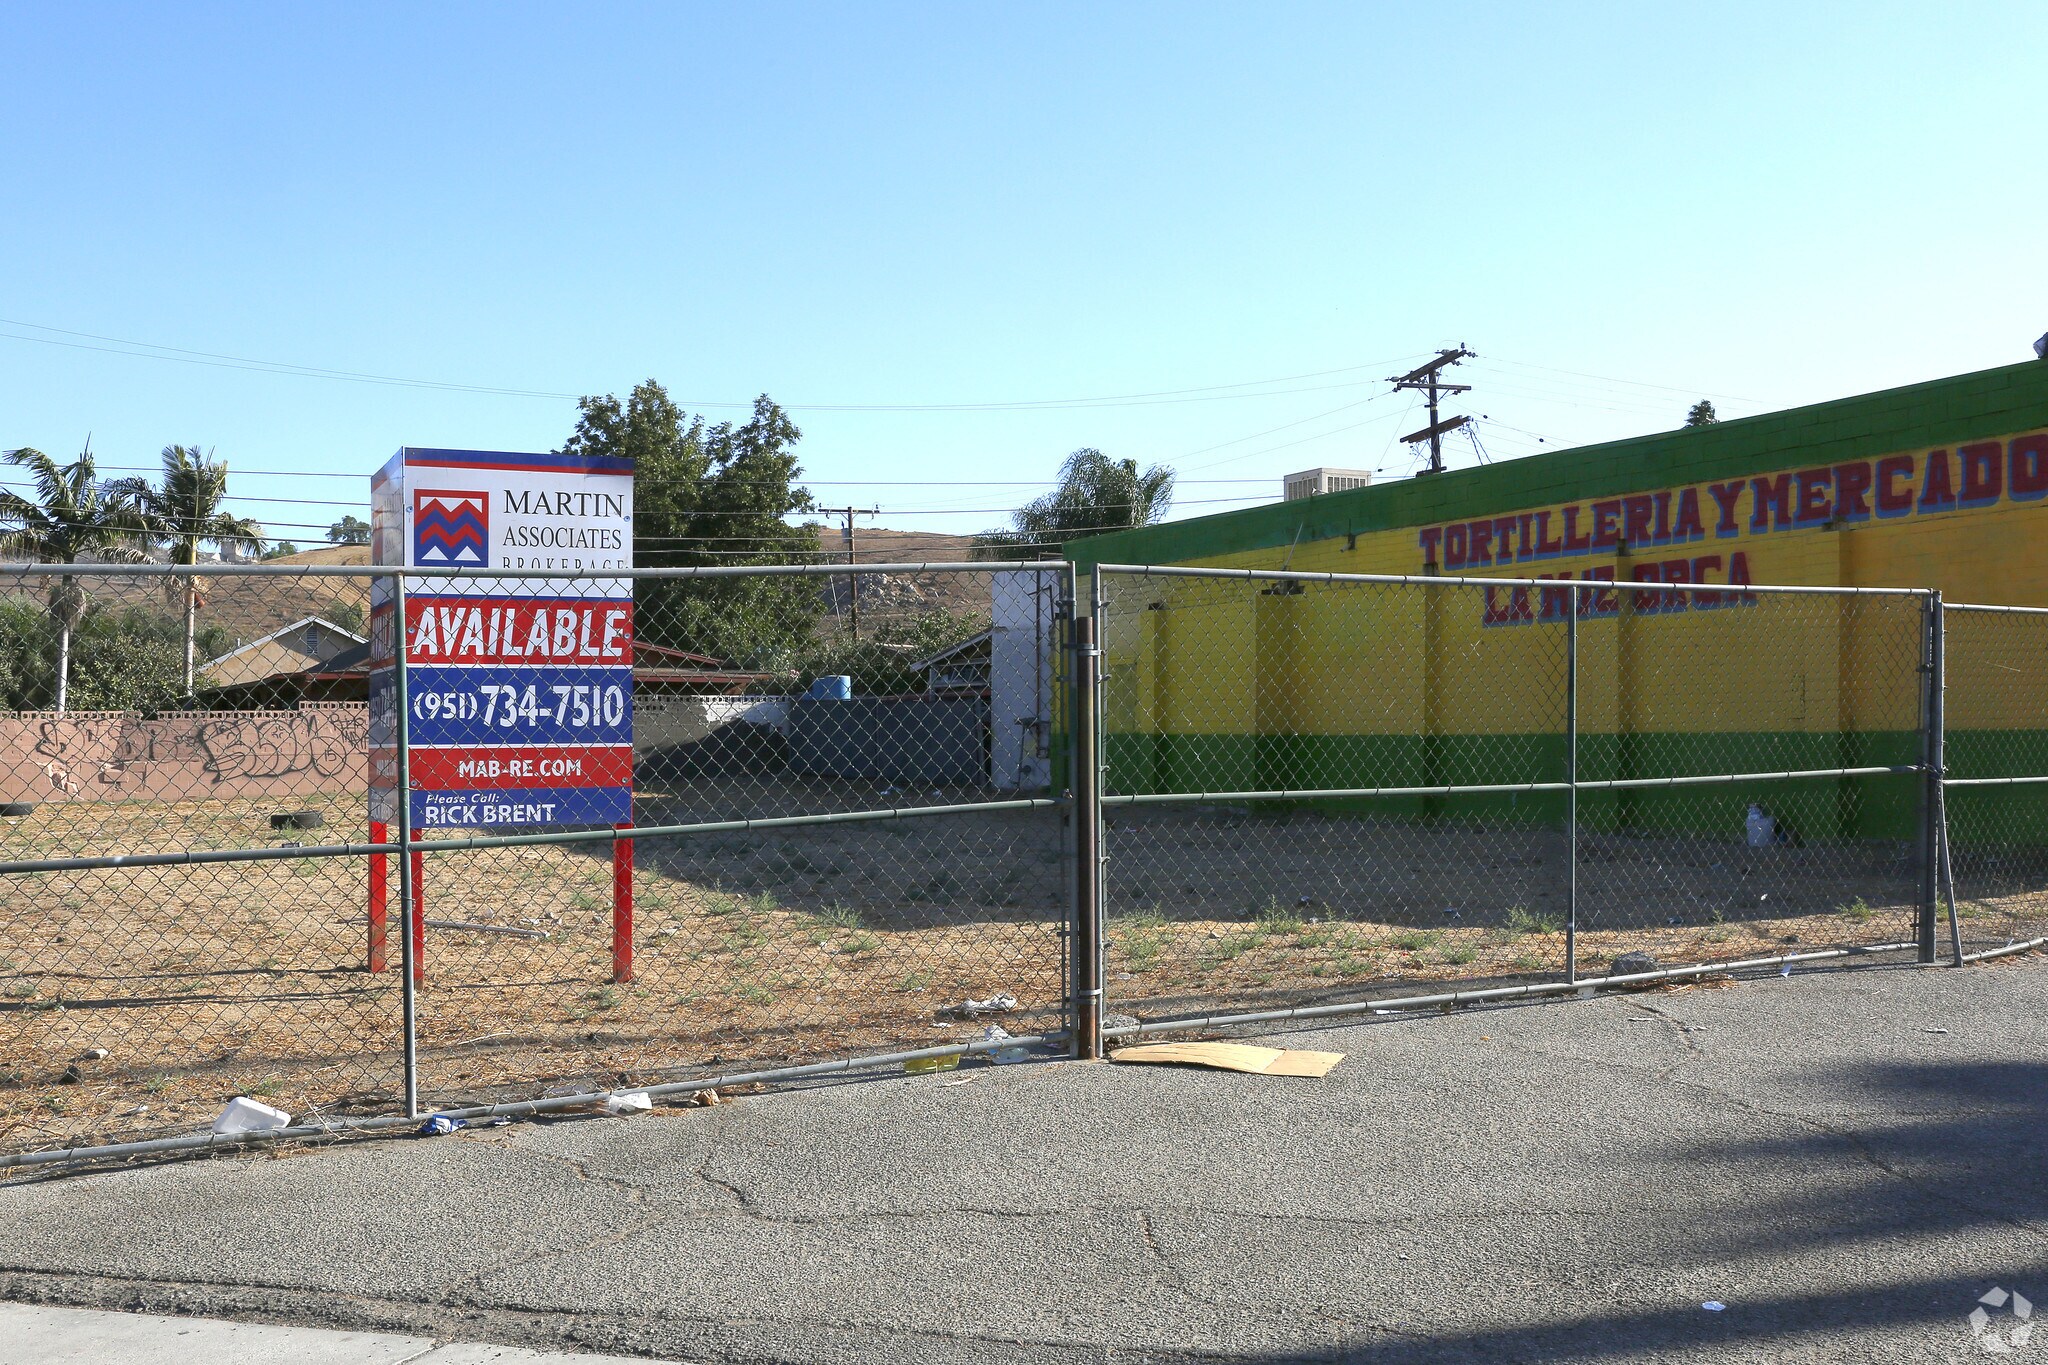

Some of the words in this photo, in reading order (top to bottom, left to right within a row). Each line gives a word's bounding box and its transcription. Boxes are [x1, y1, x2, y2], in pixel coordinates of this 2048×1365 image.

[503, 489, 625, 518] MARTIN
[1419, 487, 1705, 571] TORTILLERIA
[1750, 434, 2048, 535] MERCADO
[502, 526, 622, 550] ASSOCIATES
[412, 606, 627, 657] AVAILABLE
[413, 692, 478, 720] (951)
[480, 685, 624, 728] 734-7510
[458, 759, 582, 778] MAB-RE.COM
[425, 793, 466, 804] Please
[471, 792, 500, 804] Call:
[425, 805, 478, 825] RICK
[483, 803, 556, 824] BRENT
